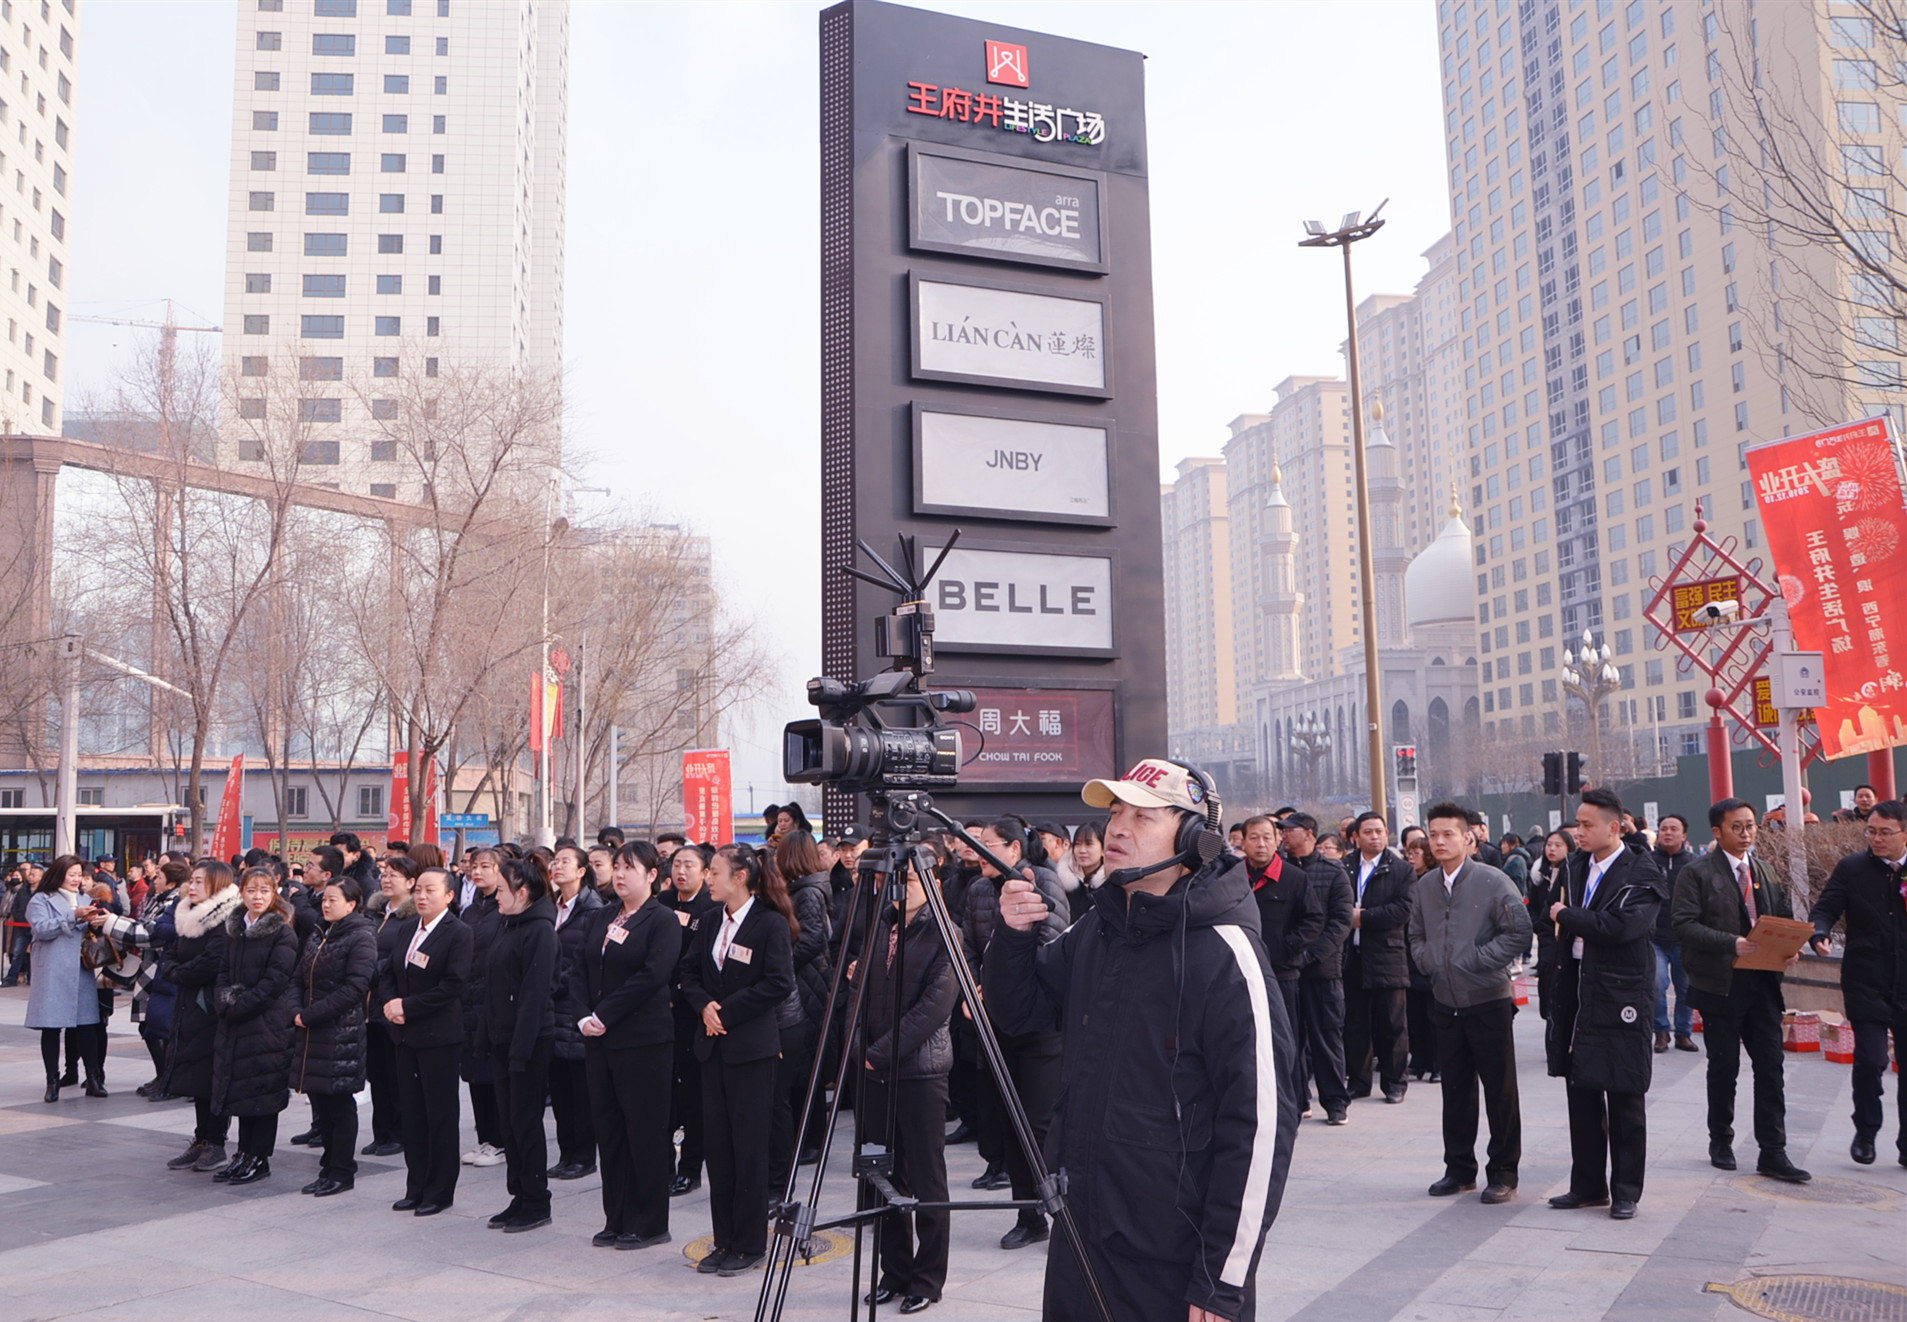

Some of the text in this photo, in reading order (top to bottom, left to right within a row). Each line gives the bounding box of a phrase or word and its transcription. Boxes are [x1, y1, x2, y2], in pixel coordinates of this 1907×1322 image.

[907, 81, 1106, 145] 王府井生活广场
[1004, 123, 1092, 144] LIFESTYLE PLAZA
[936, 191, 1081, 239] TOPFACE
[985, 450, 1043, 472] JNBY
[938, 579, 1097, 615] BELLE
[1674, 580, 1738, 609] 富强 民主
[1793, 688, 1820, 696] 公安监控
[978, 708, 1063, 737] 周大福
[978, 751, 1064, 762] CHOW TAI FOOK
